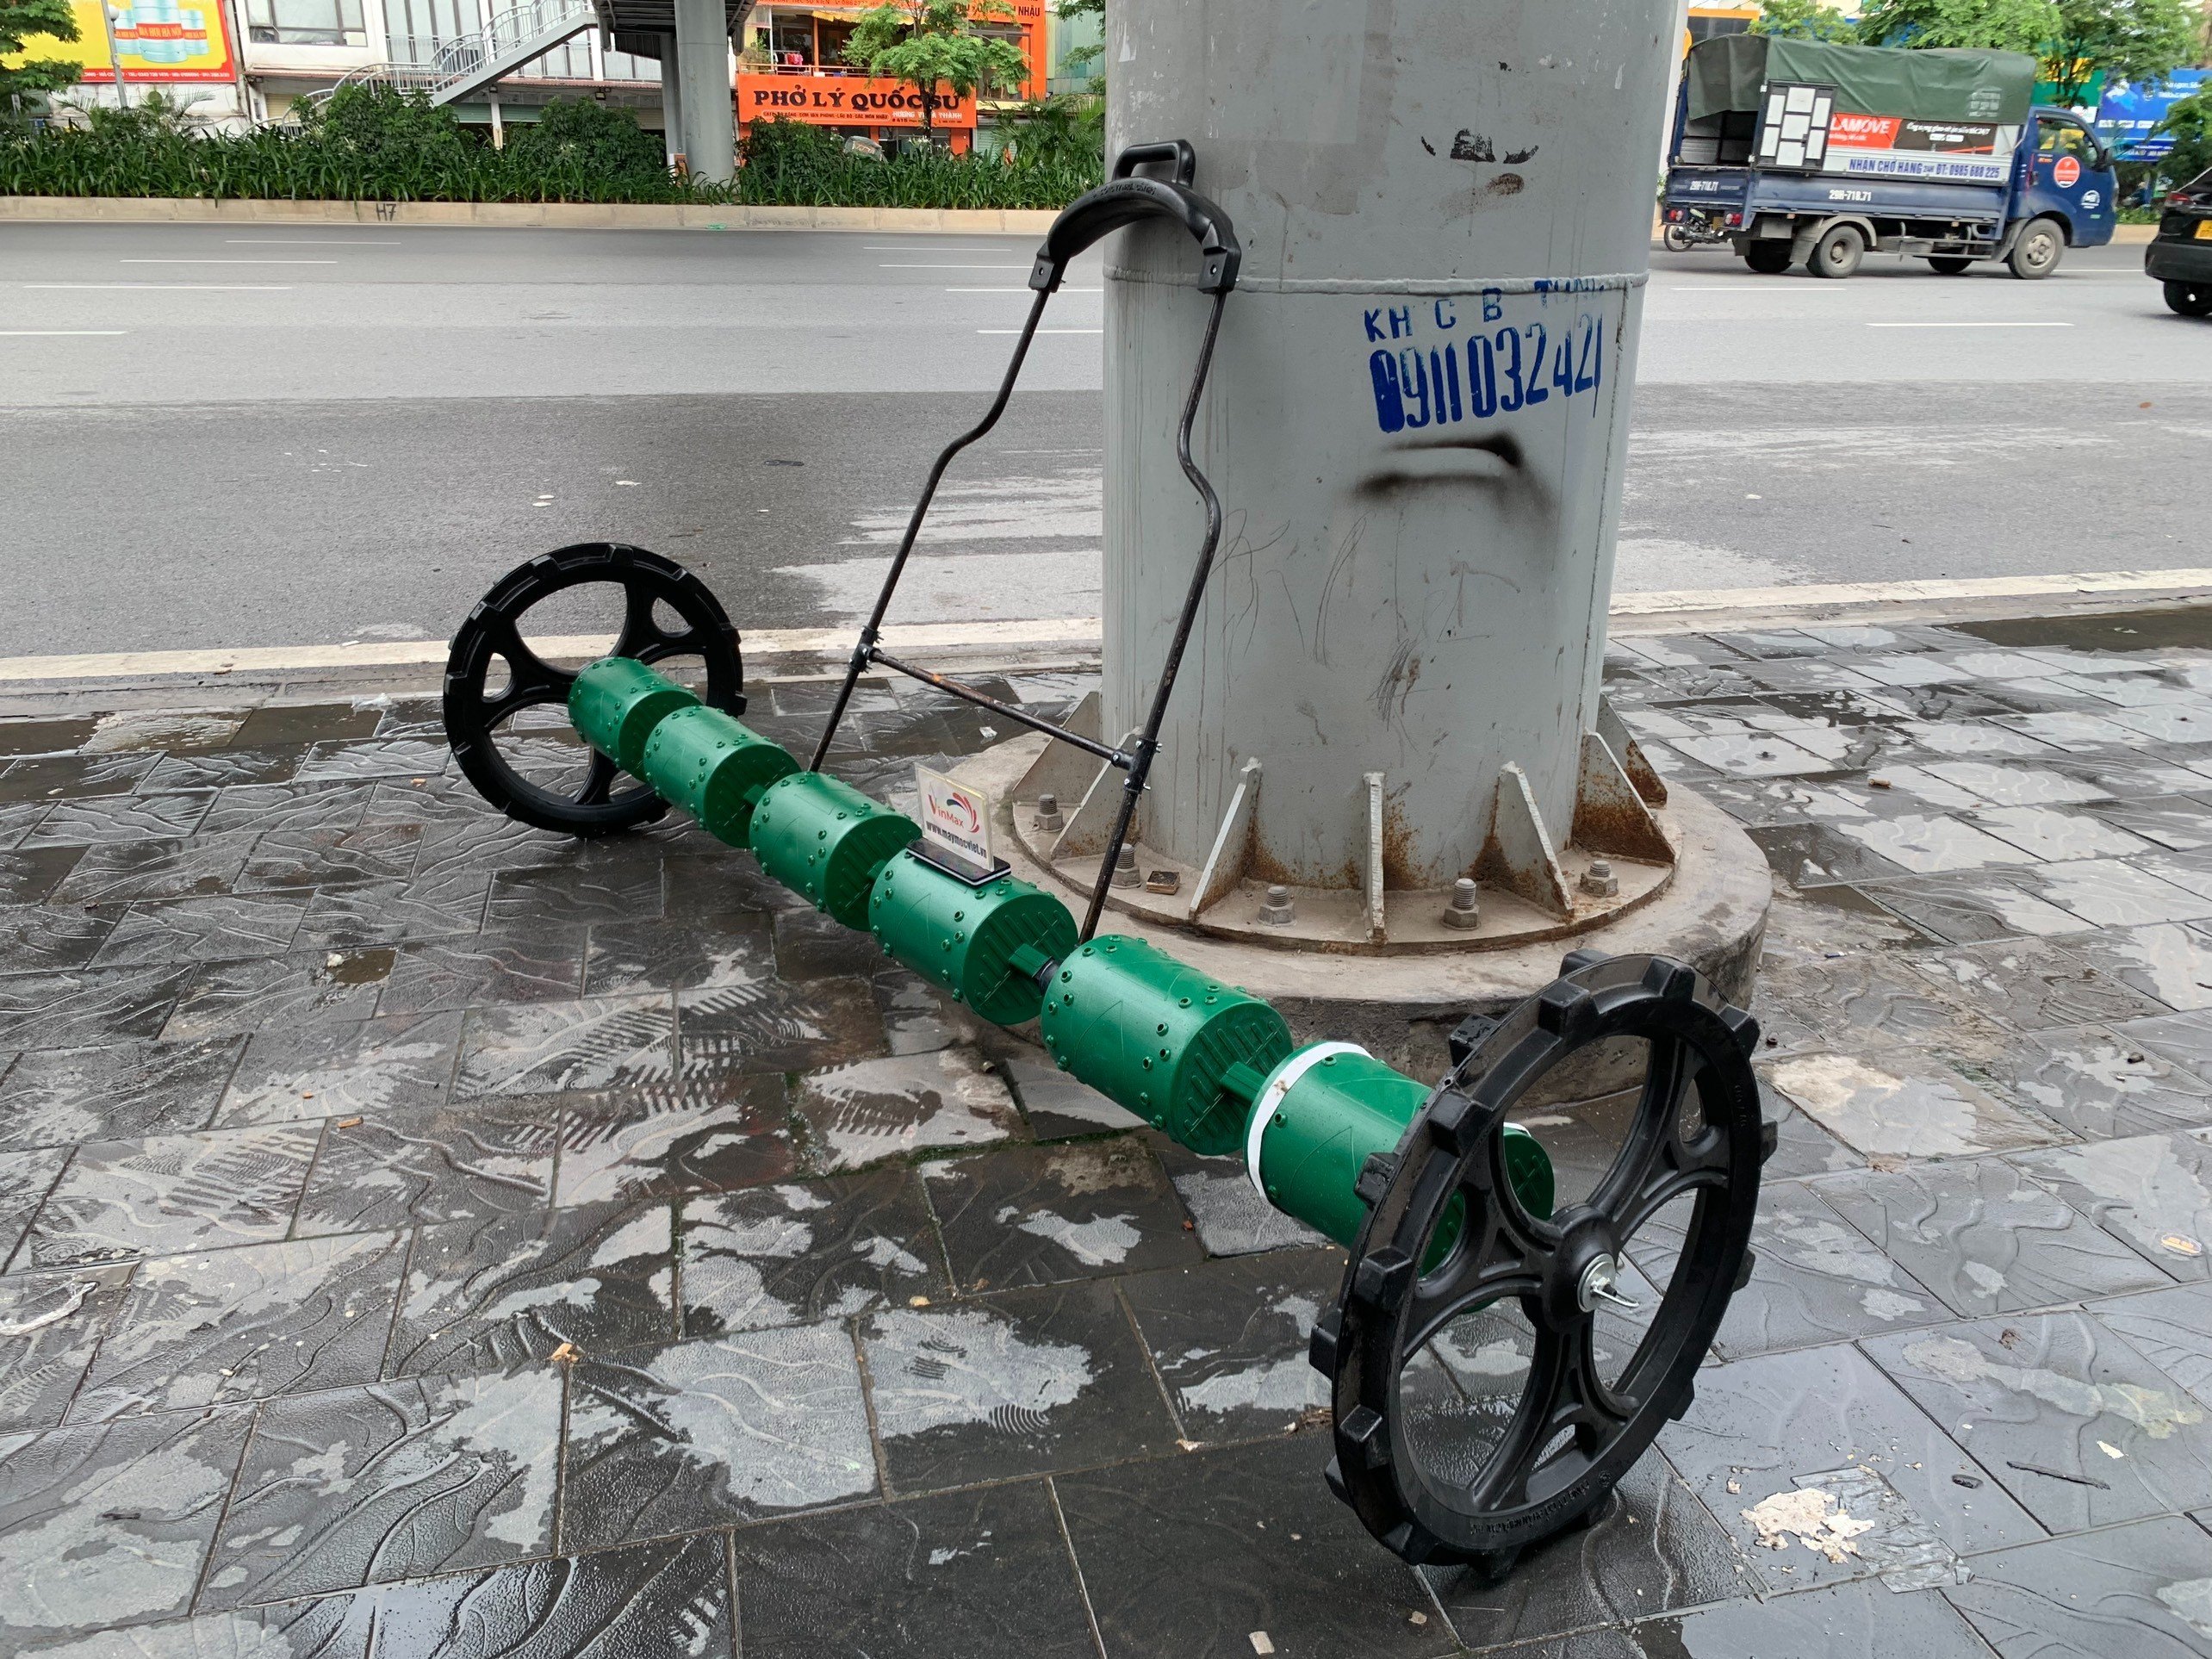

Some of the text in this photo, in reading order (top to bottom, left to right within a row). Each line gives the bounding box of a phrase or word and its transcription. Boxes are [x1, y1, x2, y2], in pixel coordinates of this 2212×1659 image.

[1018, 5, 1041, 18] NHẬU
[754, 84, 806, 107] PHỞ
[813, 88, 846, 107] LÝ
[851, 86, 923, 112] QUỐC
[1985, 166, 2001, 179] 225
[376, 202, 396, 221] H7
[925, 820, 987, 859] www.maymocviet.vn
